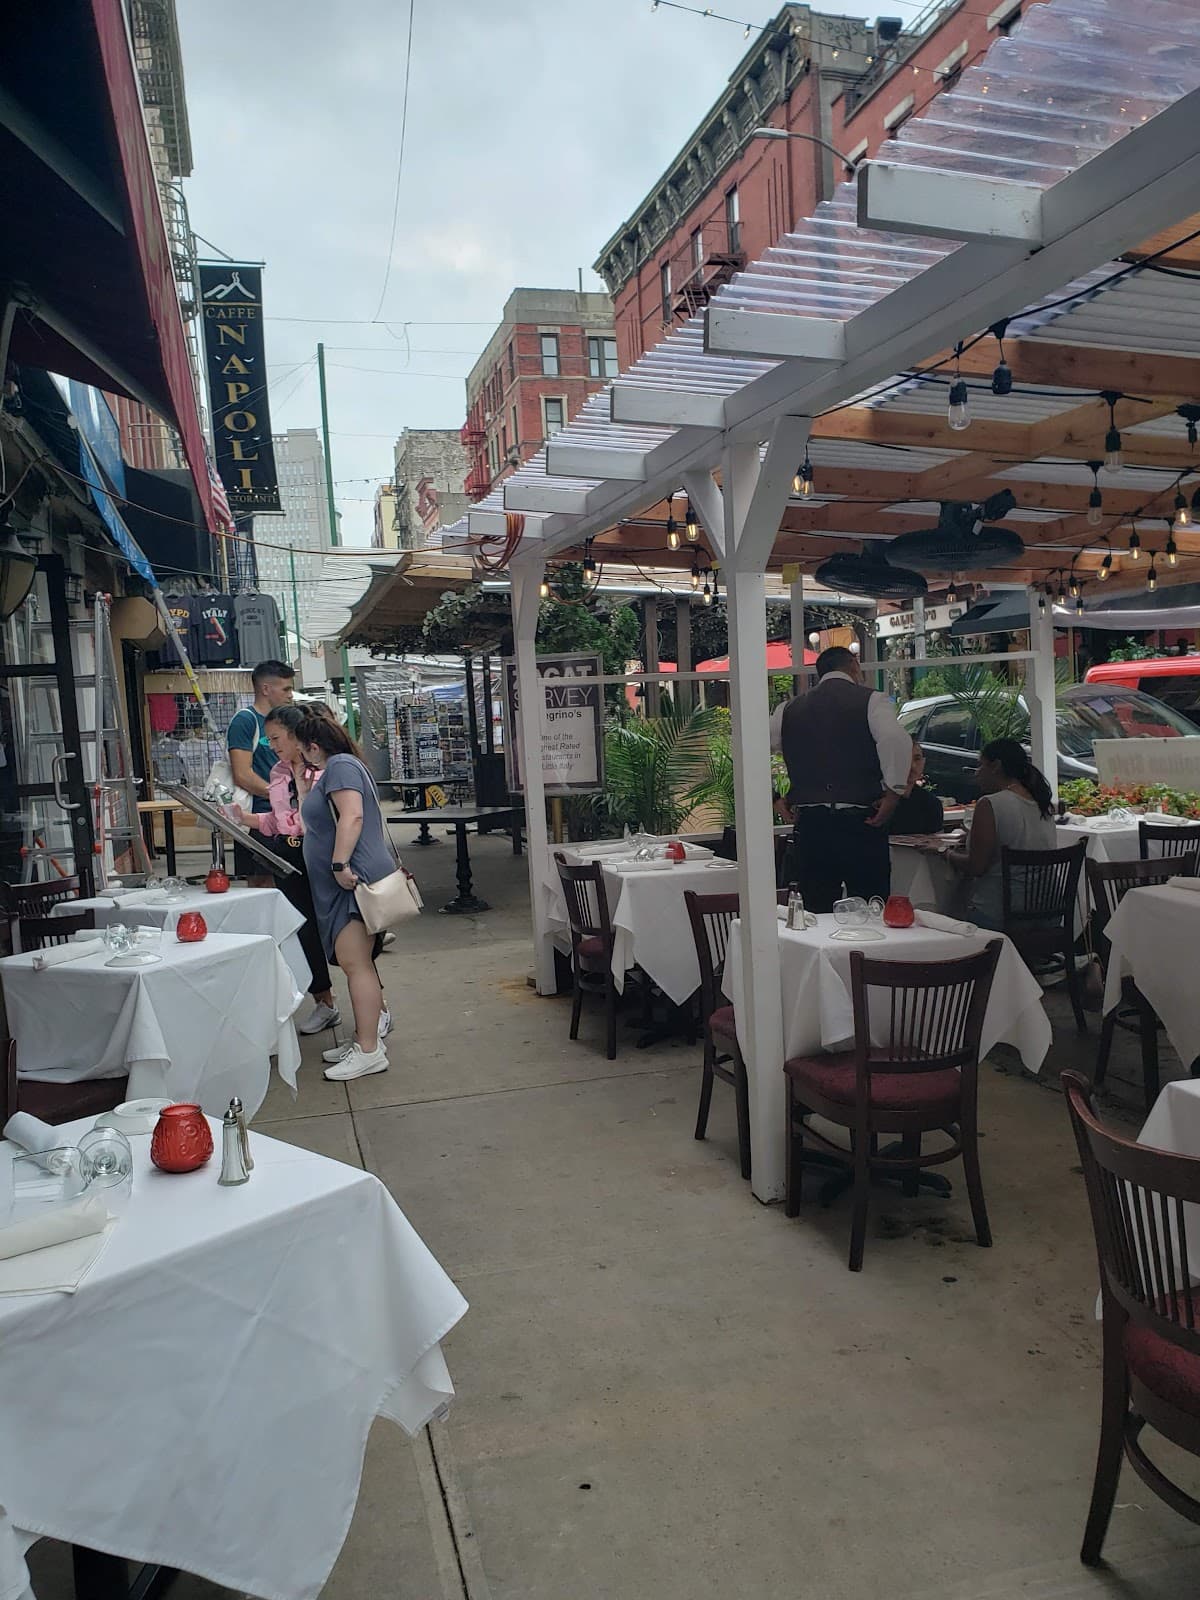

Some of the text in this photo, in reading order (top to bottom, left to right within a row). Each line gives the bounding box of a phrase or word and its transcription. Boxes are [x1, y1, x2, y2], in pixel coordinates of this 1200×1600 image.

[206, 307, 257, 320] CAFFE
[216, 323, 259, 490] NAPOLI
[168, 608, 190, 619] YPD
[202, 608, 228, 619] ITALY
[546, 710, 582, 721] grino's
